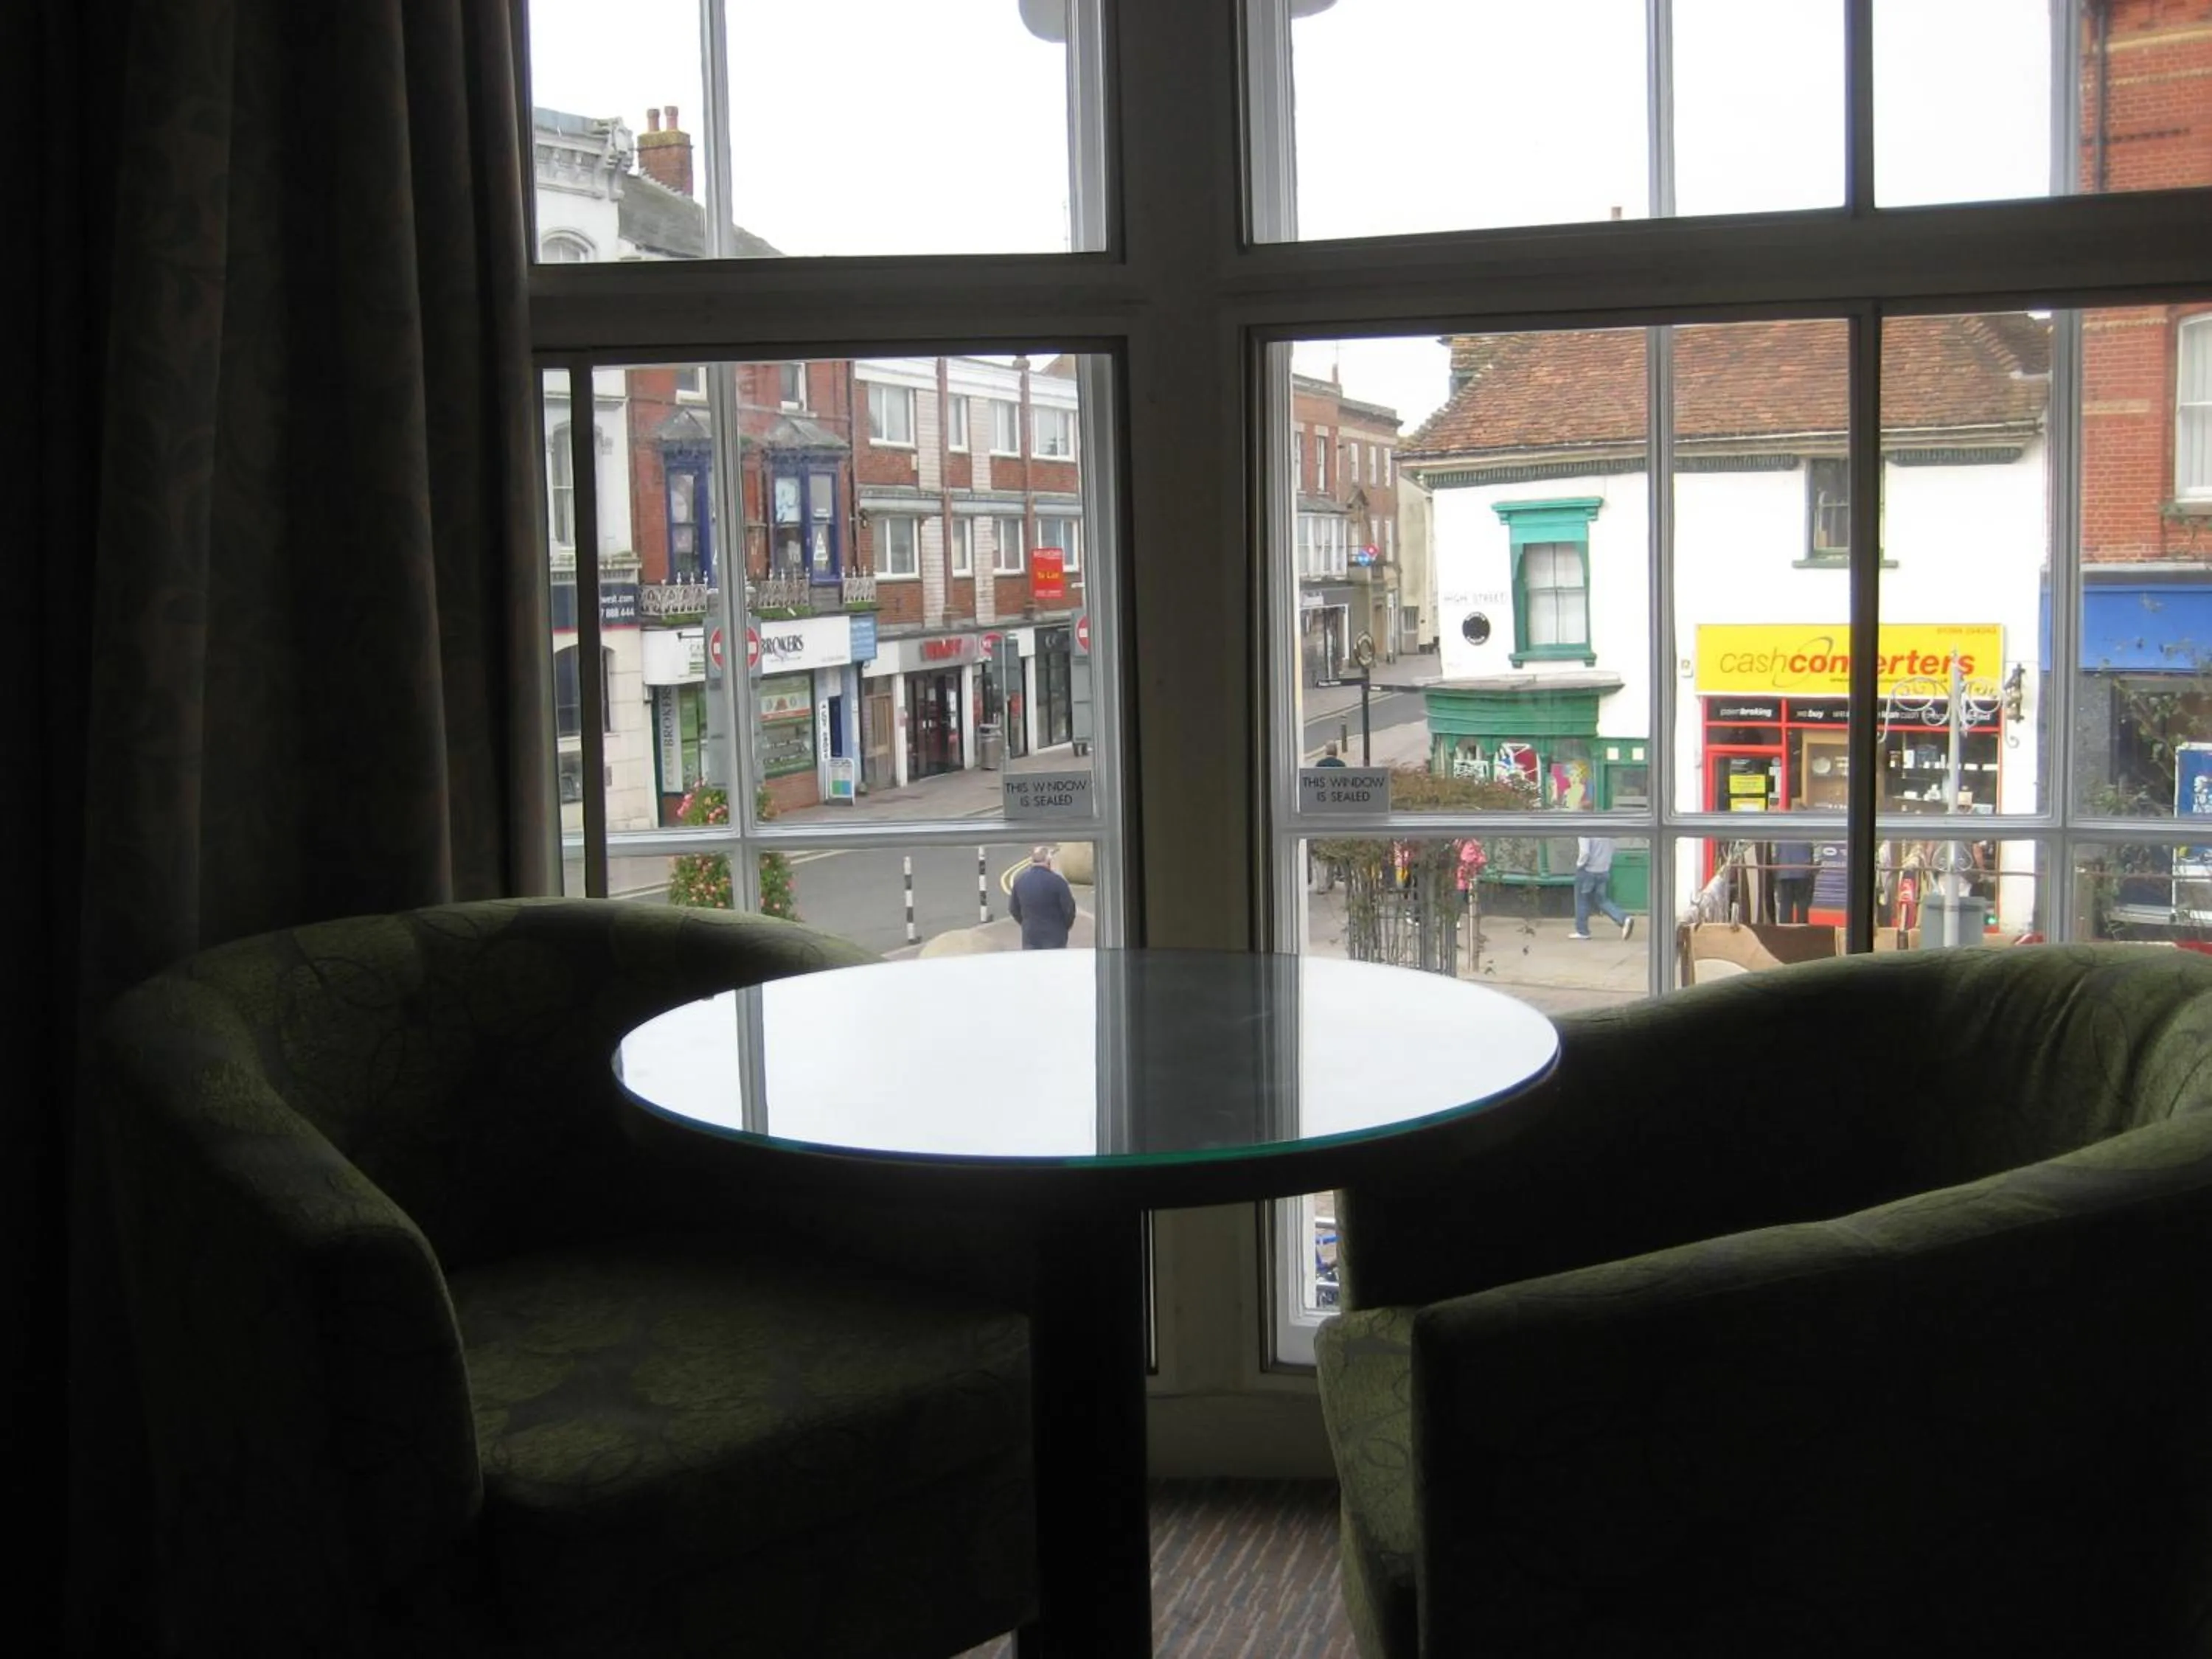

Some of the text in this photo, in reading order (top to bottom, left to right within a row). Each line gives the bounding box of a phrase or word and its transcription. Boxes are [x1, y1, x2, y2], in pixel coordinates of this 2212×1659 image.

[760, 635, 804, 655] BROKERS
[1006, 779, 1088, 794] THIS WINDOW
[1302, 776, 1385, 788] THIS WINDOW
[1020, 794, 1073, 807] IS SEALED
[1316, 791, 1371, 802] IS SEALED
